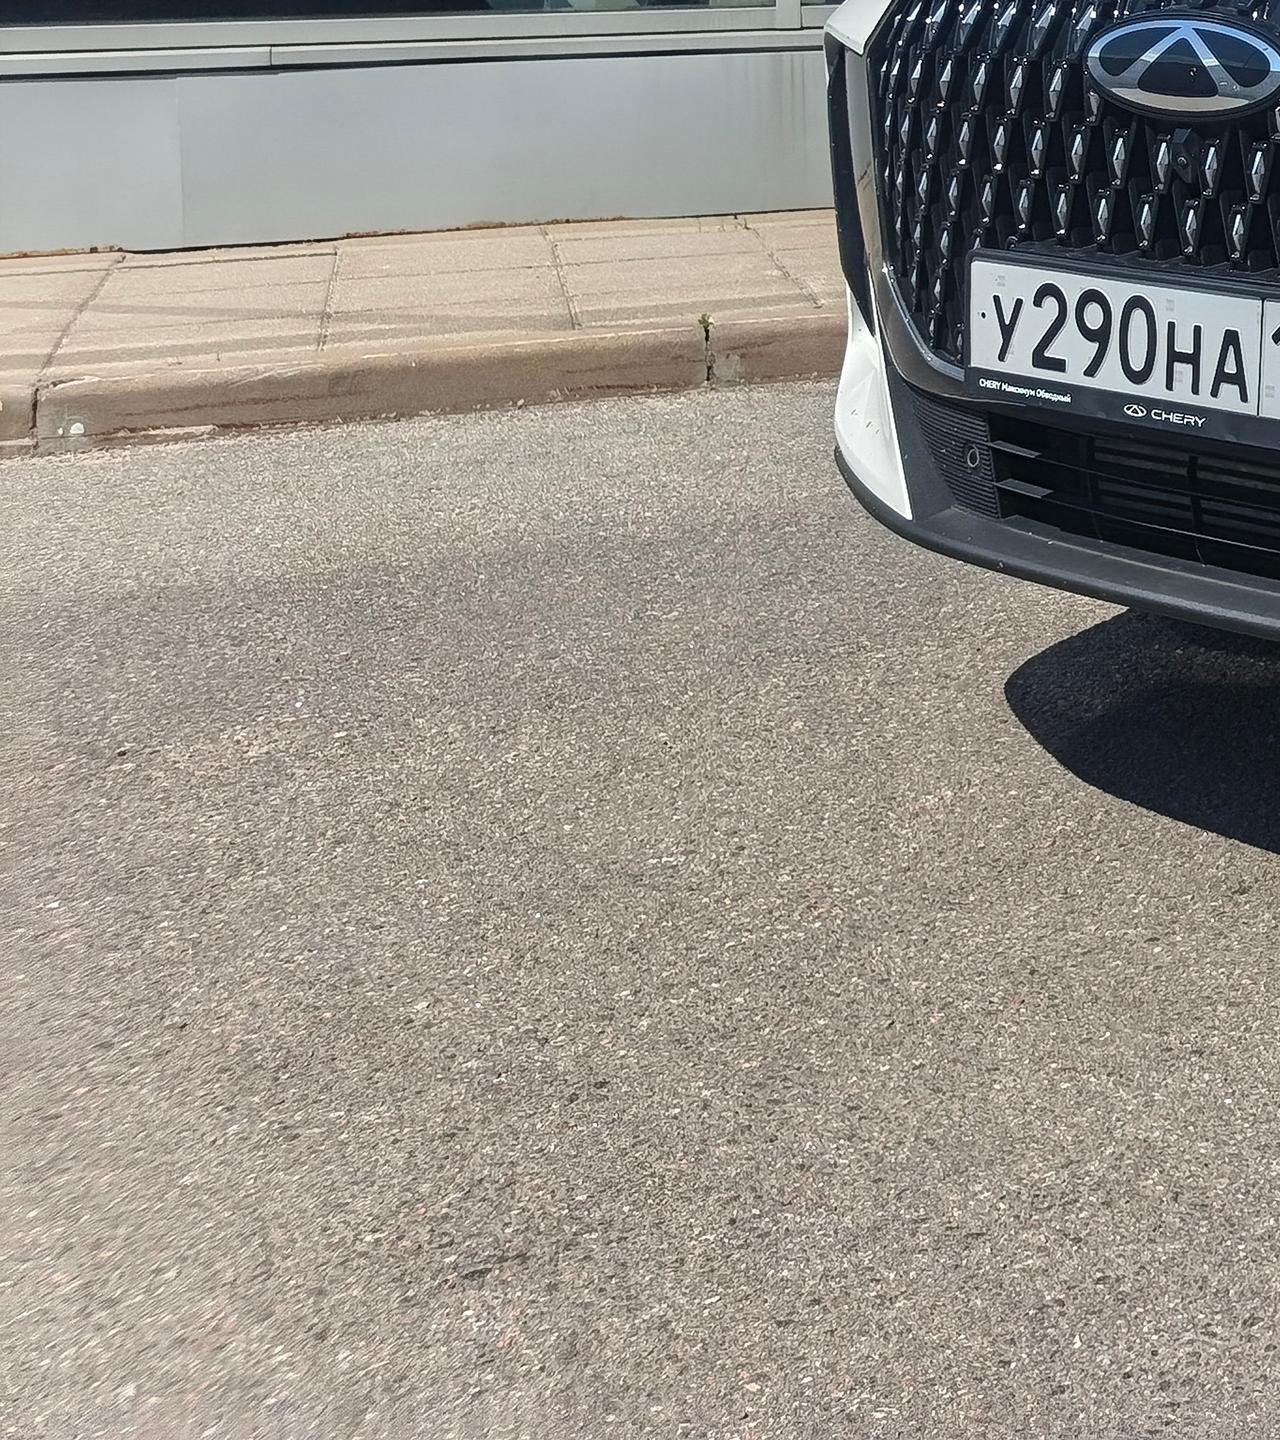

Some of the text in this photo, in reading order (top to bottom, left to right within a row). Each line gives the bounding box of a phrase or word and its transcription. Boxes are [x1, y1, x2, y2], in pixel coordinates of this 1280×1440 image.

[992, 281, 1250, 404] У290НА
[979, 378, 1002, 391] CHERY
[1150, 409, 1207, 428] CHERY
